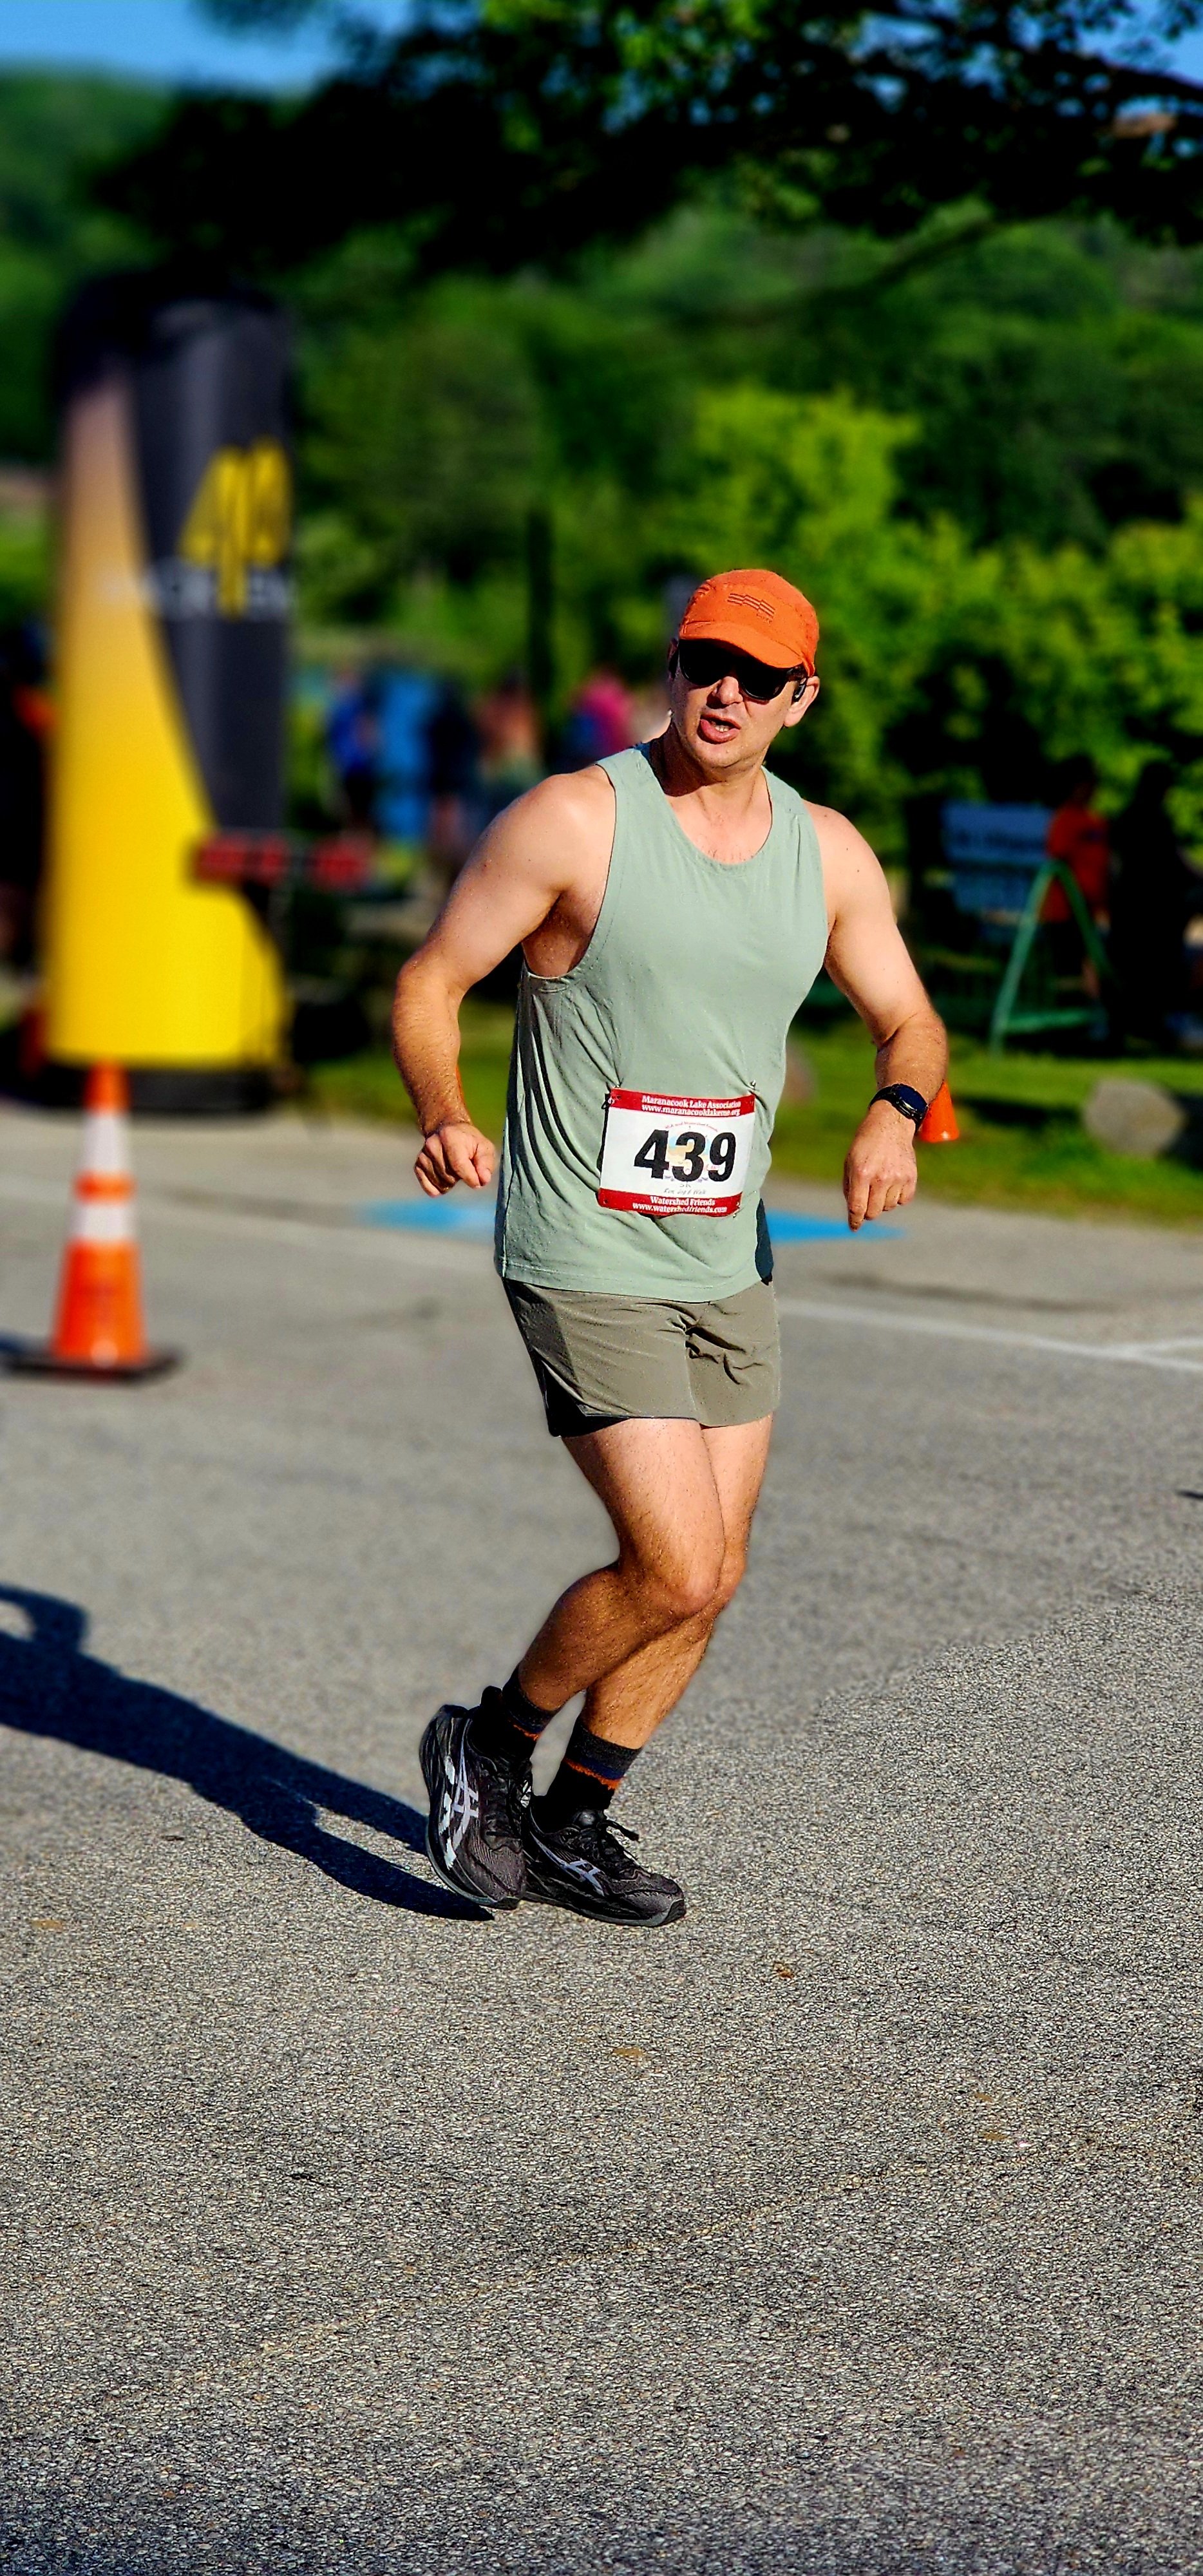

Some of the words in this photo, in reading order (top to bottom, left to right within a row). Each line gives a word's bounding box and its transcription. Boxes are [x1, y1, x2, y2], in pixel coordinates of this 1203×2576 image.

[642, 1095, 688, 1108] Maranacook
[689, 1100, 706, 1108] Lake
[634, 1129, 736, 1182] 439
[650, 1196, 689, 1206] Watershed
[690, 1198, 715, 1206] Friends
[632, 1202, 727, 1213] www.watershedfriends.com
